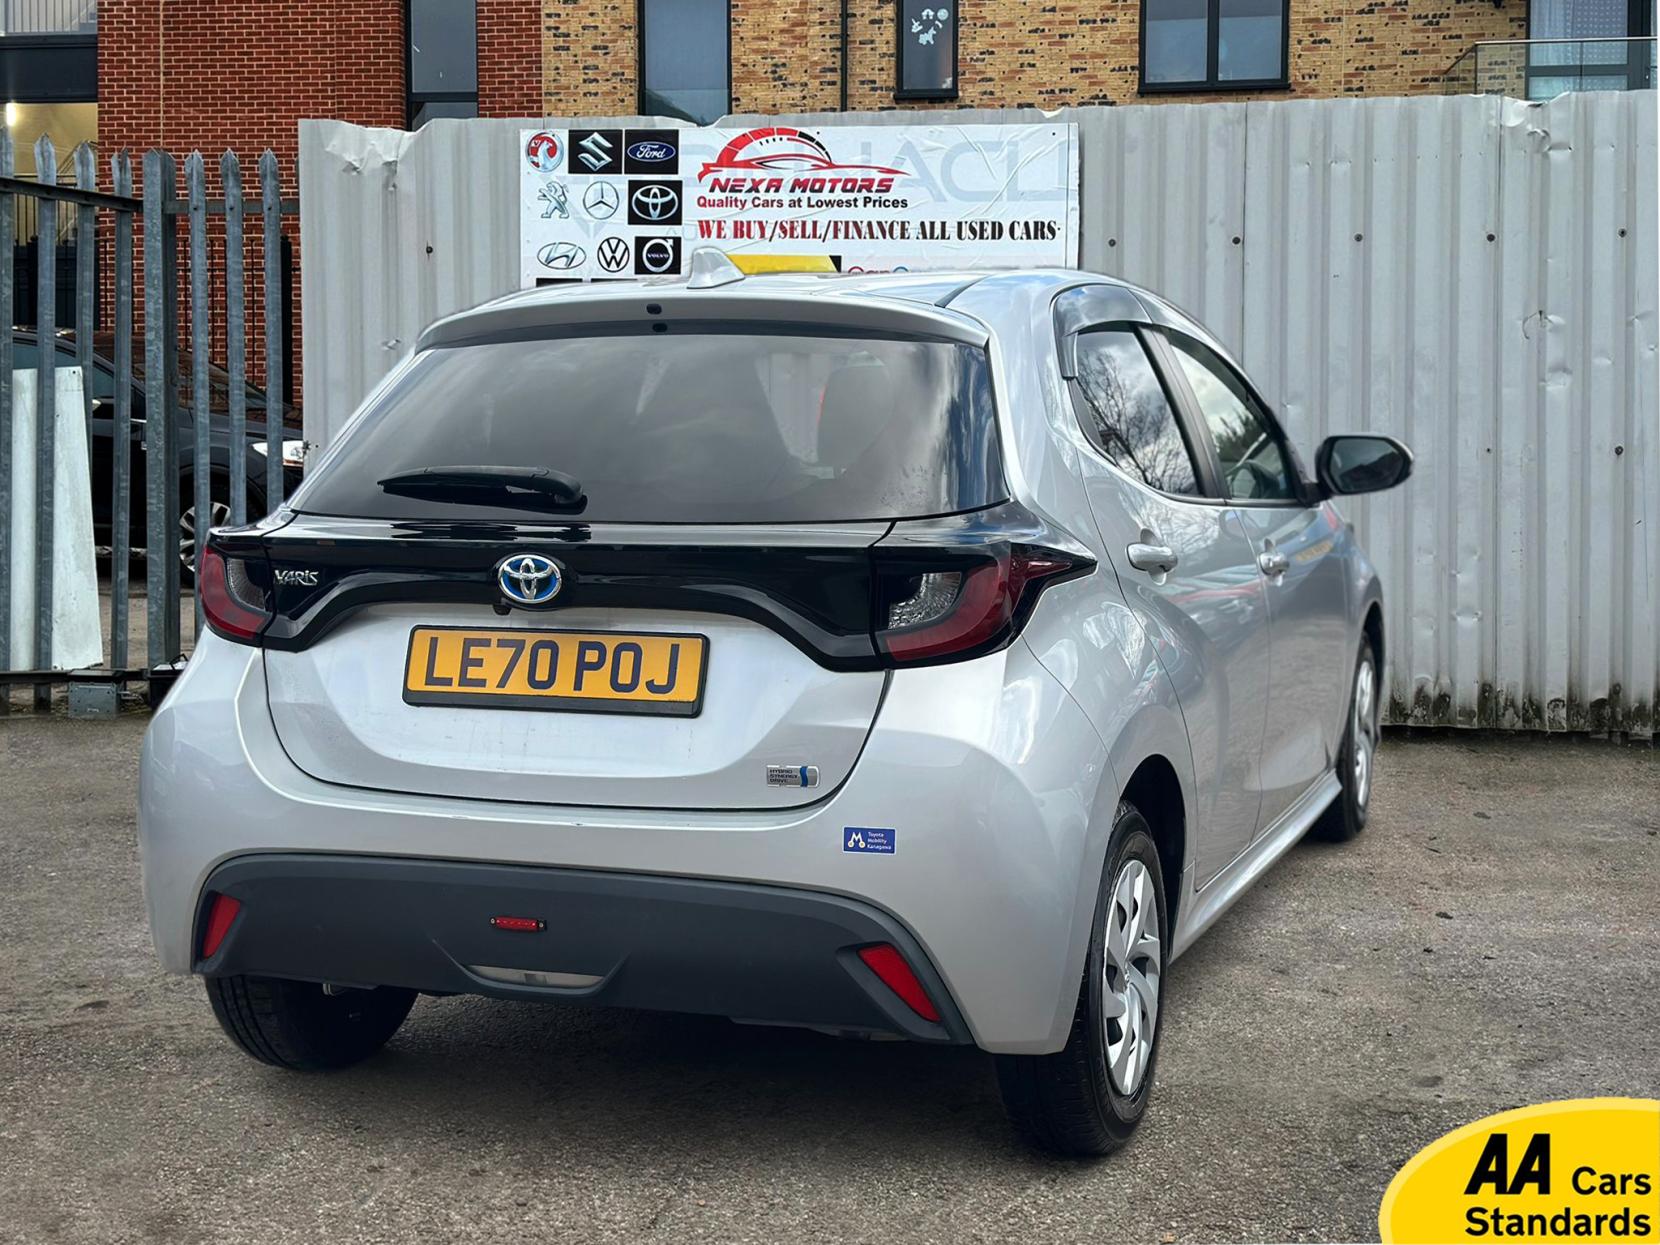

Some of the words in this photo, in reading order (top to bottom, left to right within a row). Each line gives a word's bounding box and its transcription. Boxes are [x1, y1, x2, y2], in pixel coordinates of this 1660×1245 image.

[636, 143, 667, 159] Ford
[708, 177, 783, 194] NEXA
[789, 177, 895, 194] MOTORS
[697, 196, 748, 210] Quality
[751, 196, 784, 208] Cars
[788, 197, 803, 208] at
[807, 196, 858, 208] Lowest
[863, 196, 908, 208] Prices
[697, 219, 727, 240] WE
[916, 219, 951, 241] ALL
[956, 219, 1004, 241] USED
[424, 636, 560, 690] LE70
[573, 641, 681, 695] POJ
